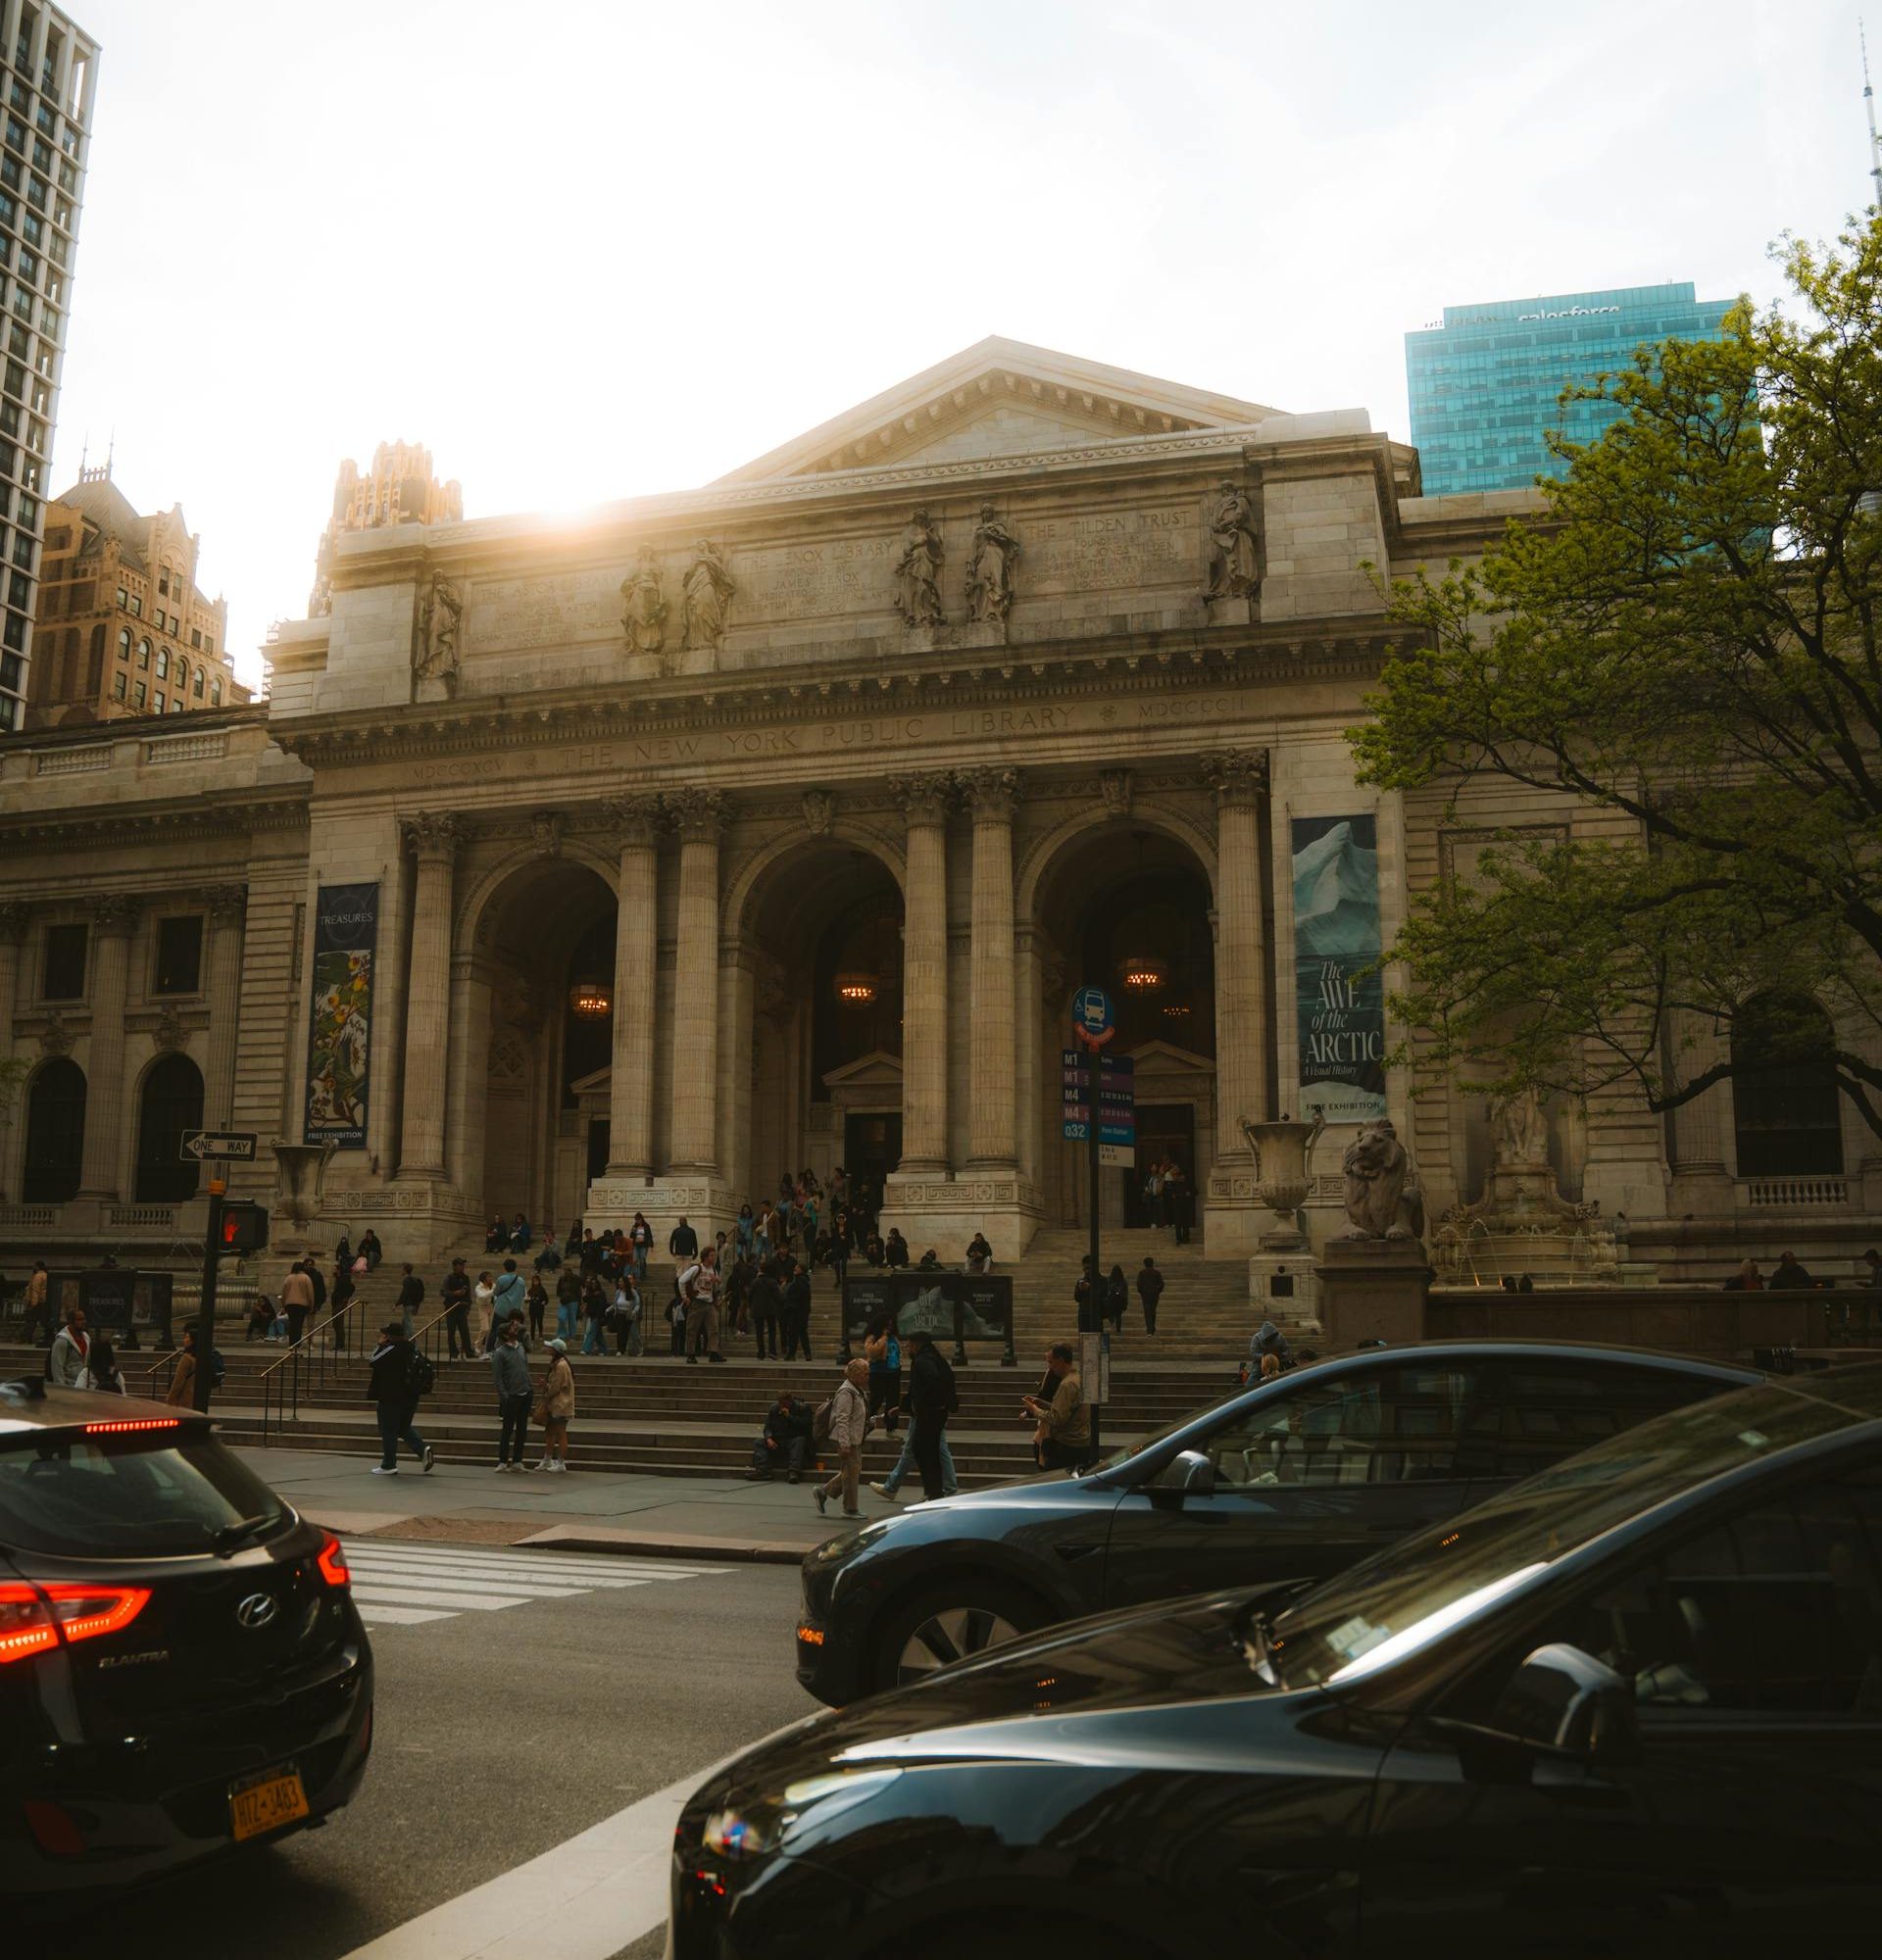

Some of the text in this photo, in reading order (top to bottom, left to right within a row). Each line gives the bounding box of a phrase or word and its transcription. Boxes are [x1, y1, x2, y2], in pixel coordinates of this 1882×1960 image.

[1026, 511, 1190, 538] THE TILDEN TRUST
[742, 540, 893, 570] THE LENOX LIBRARY
[414, 696, 1246, 780] MDCCCXCV THE NEW YORK PUBLIC LIBRARY MDCCCCII
[320, 911, 373, 926] TREASURES
[1320, 960, 1344, 980] The
[1316, 979, 1361, 1008] AWE
[1311, 1009, 1349, 1034] of the
[1305, 1030, 1382, 1063] ARCTIC
[1065, 1053, 1078, 1066] M1
[1065, 1070, 1078, 1083] M1
[1310, 1064, 1331, 1076] Visual
[1332, 1064, 1358, 1078] History
[1065, 1089, 1079, 1101] M4
[1065, 1106, 1079, 1119] M4
[1328, 1101, 1380, 1111] EXHIBITION
[1065, 1124, 1086, 1138] Q32
[193, 1139, 249, 1152] ONE WAY
[98, 1650, 170, 1668] ELANTRA
